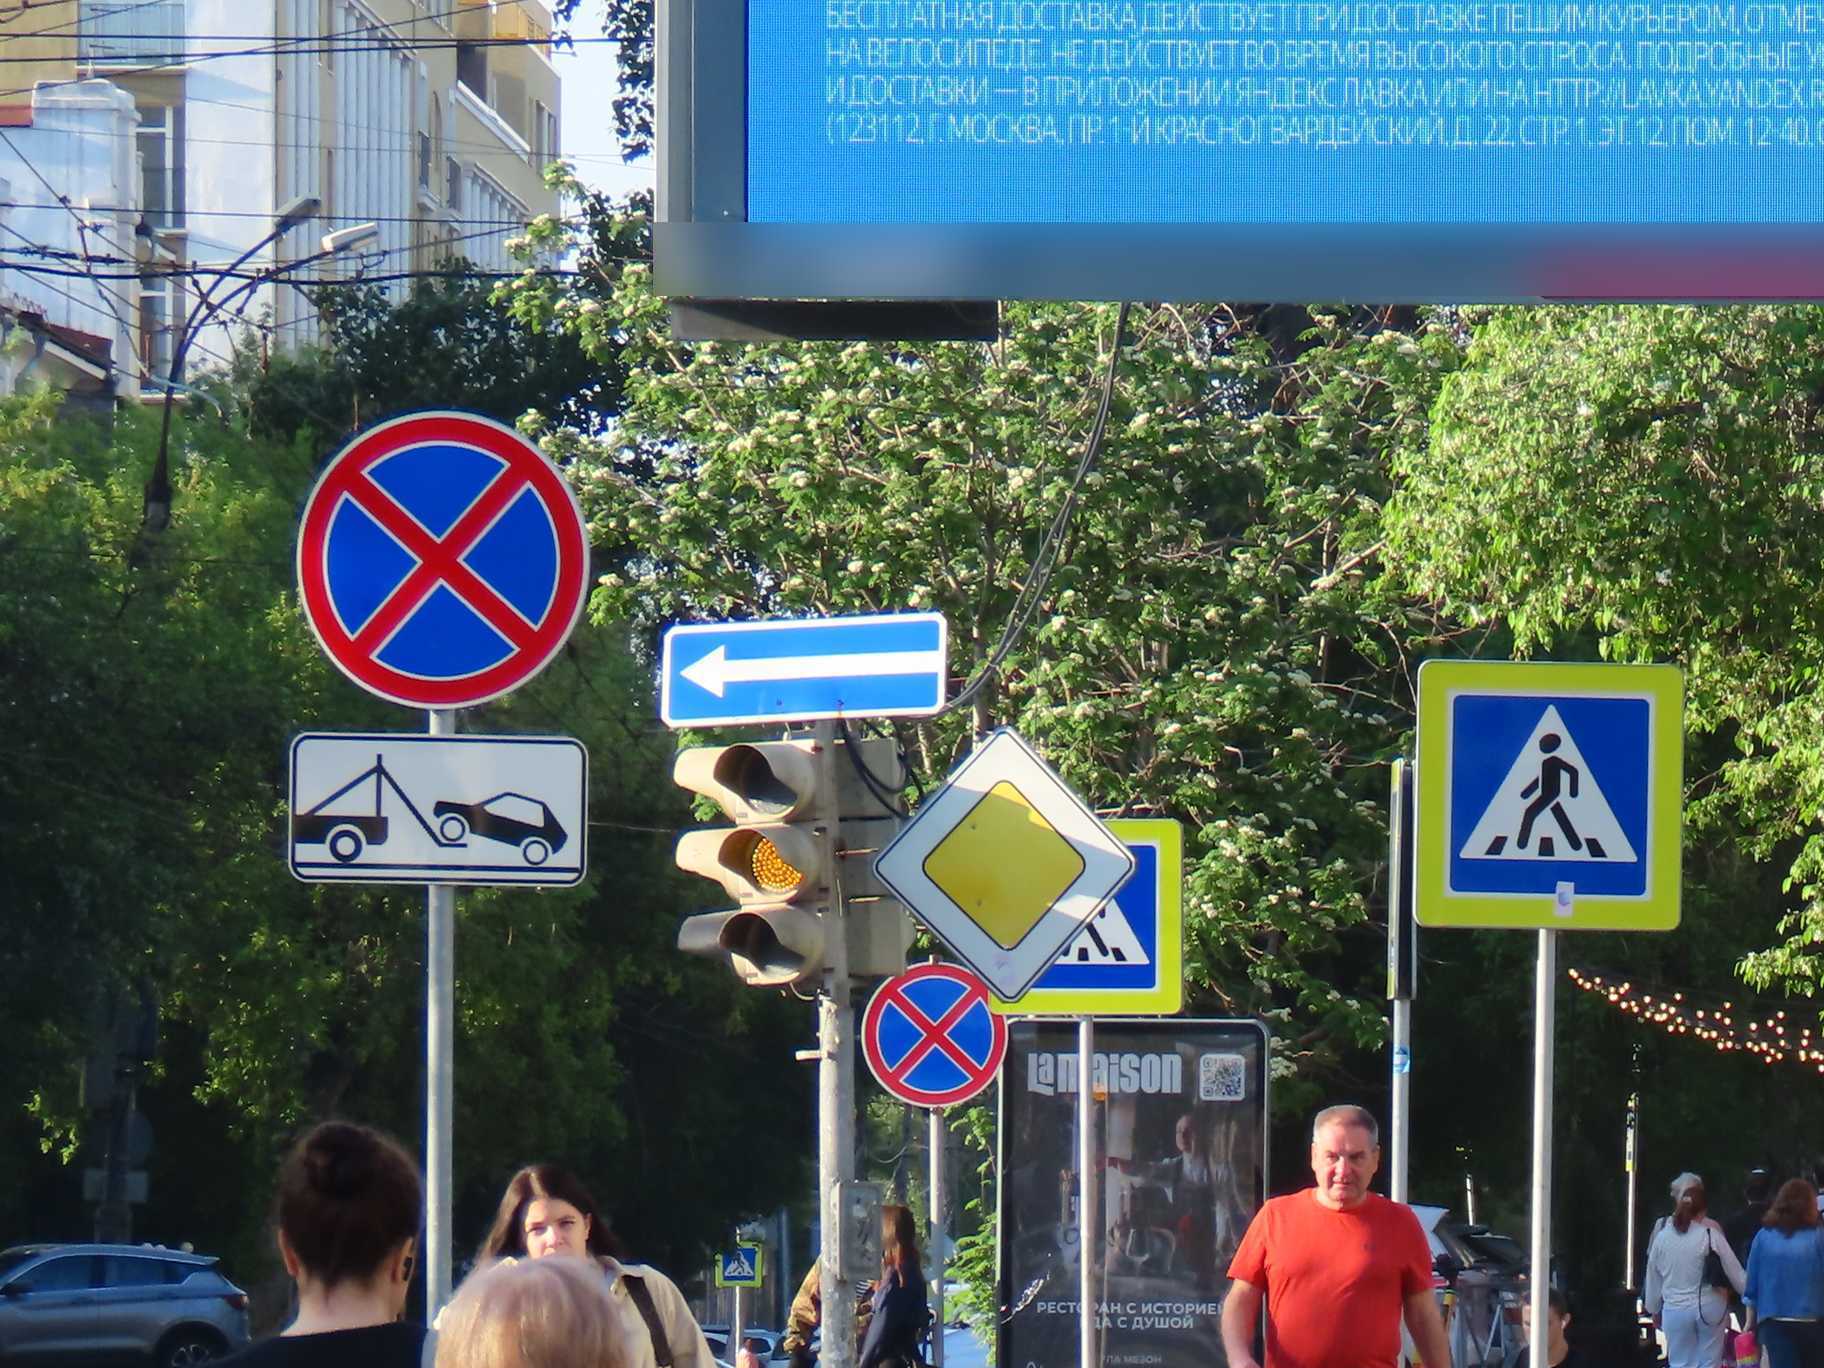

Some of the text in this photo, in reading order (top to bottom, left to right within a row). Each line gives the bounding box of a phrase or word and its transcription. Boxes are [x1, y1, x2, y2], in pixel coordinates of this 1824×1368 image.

[826, 1, 995, 29] БЕСПЛАТНАЯ
[997, 1, 1137, 33] ДОСТАВКА
[1295, 2, 1349, 30] ПРИ
[1352, 3, 1488, 34] ДОСТАВКЕ
[1491, 3, 1595, 31] ПЕШИМ
[1600, 3, 1741, 35] КУРЬЕРОМ,
[826, 38, 862, 67] НА
[1051, 38, 1086, 67] НЕ
[1087, 33, 1240, 71] ДЕЙСТВУЕТ
[1243, 39, 1280, 68] ВО
[1283, 39, 1370, 68] ВРЕМЯ
[1374, 40, 1516, 69] ВЫСОКОГО
[1637, 41, 1803, 73] ПОДРОБНЫЕ
[826, 76, 846, 105] И
[847, 76, 989, 109] ДОСТАВКИ
[1023, 76, 1039, 106] В
[1043, 77, 1232, 106] ПРИЛОЖЕНИИ
[1433, 78, 1489, 107] ИЛИ
[1493, 78, 1530, 107] НА
[1117, 1317, 1128, 1329] С
[1132, 1315, 1194, 1330] ДУШОЙ
[1126, 1303, 1137, 1314] С
